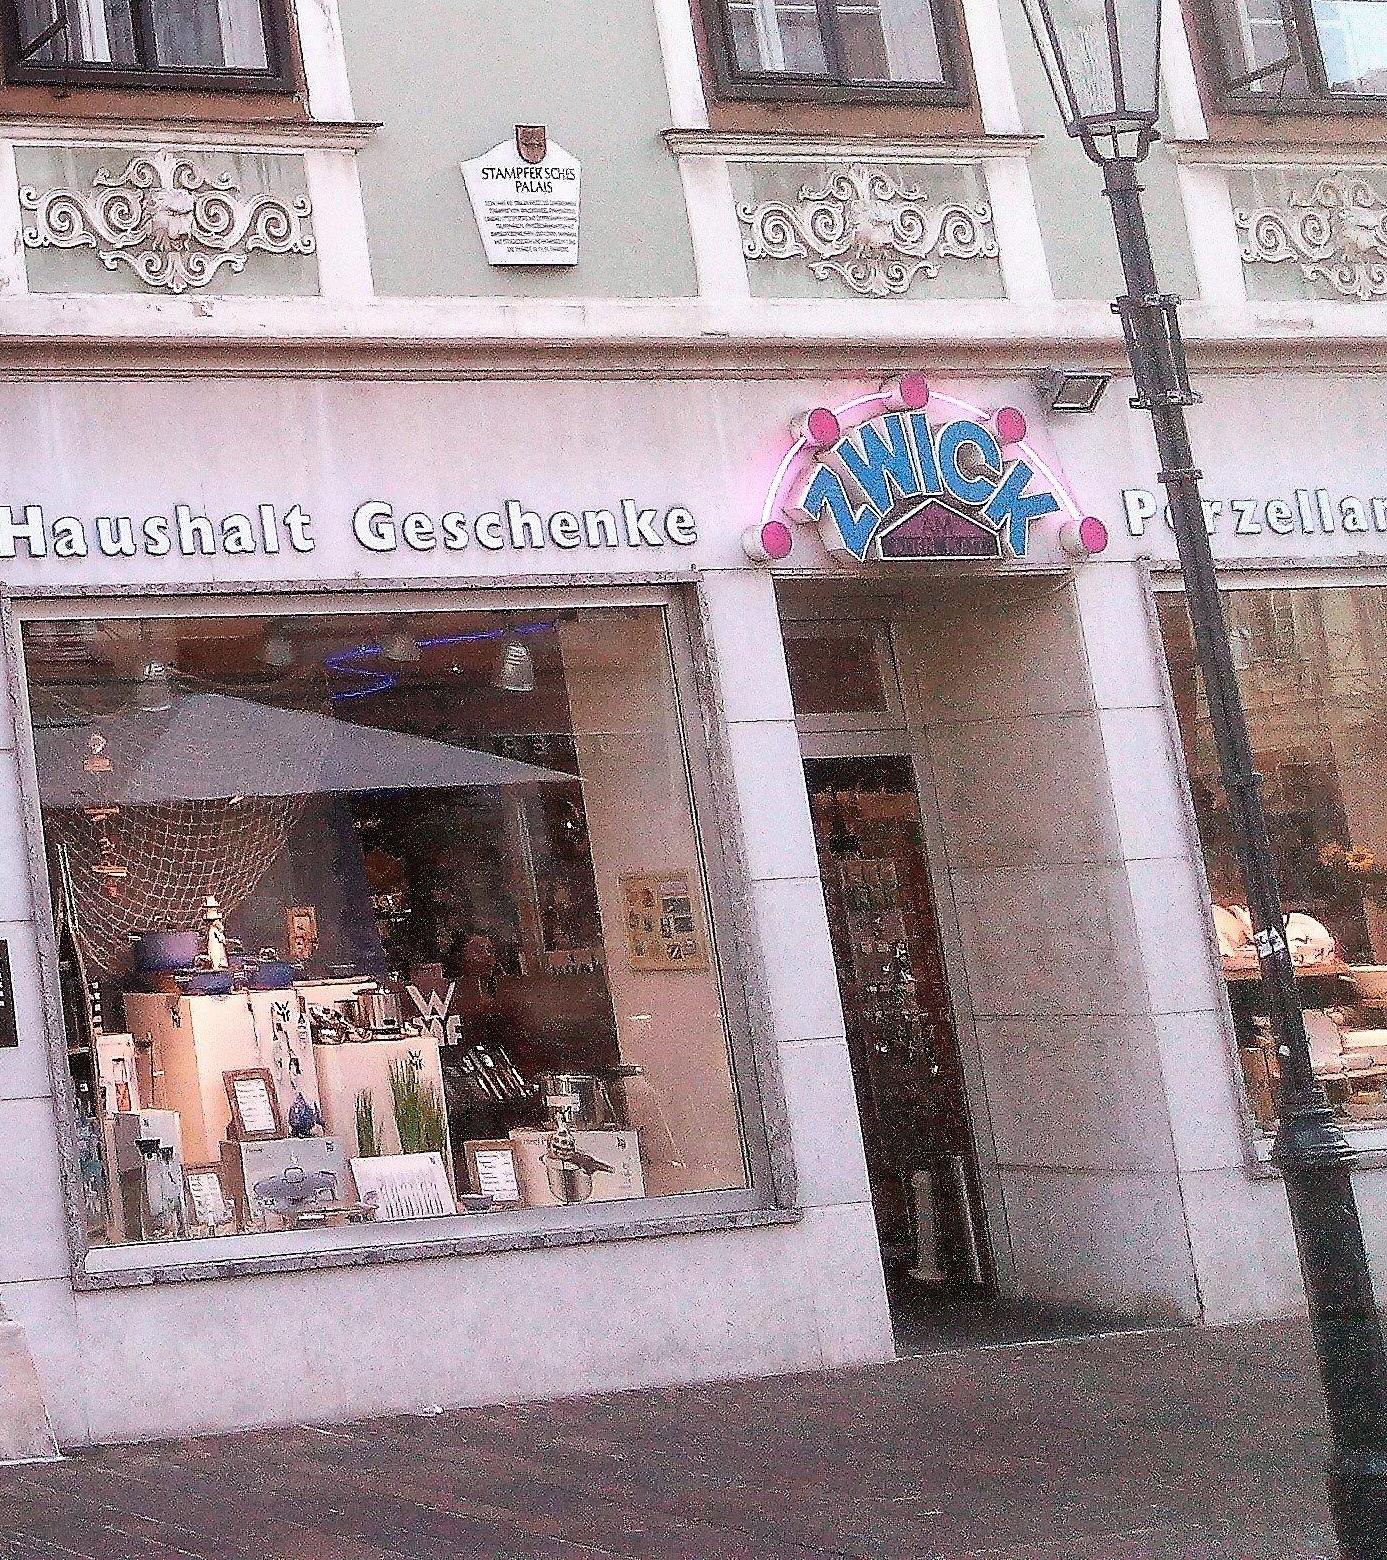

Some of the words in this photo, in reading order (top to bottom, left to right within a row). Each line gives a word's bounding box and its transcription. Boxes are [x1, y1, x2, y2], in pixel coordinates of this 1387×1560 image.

[515, 180, 553, 193] PALAIS
[802, 412, 1061, 561] ZWICK
[351, 498, 698, 552] Geschenke
[1121, 488, 1387, 536] Przellan
